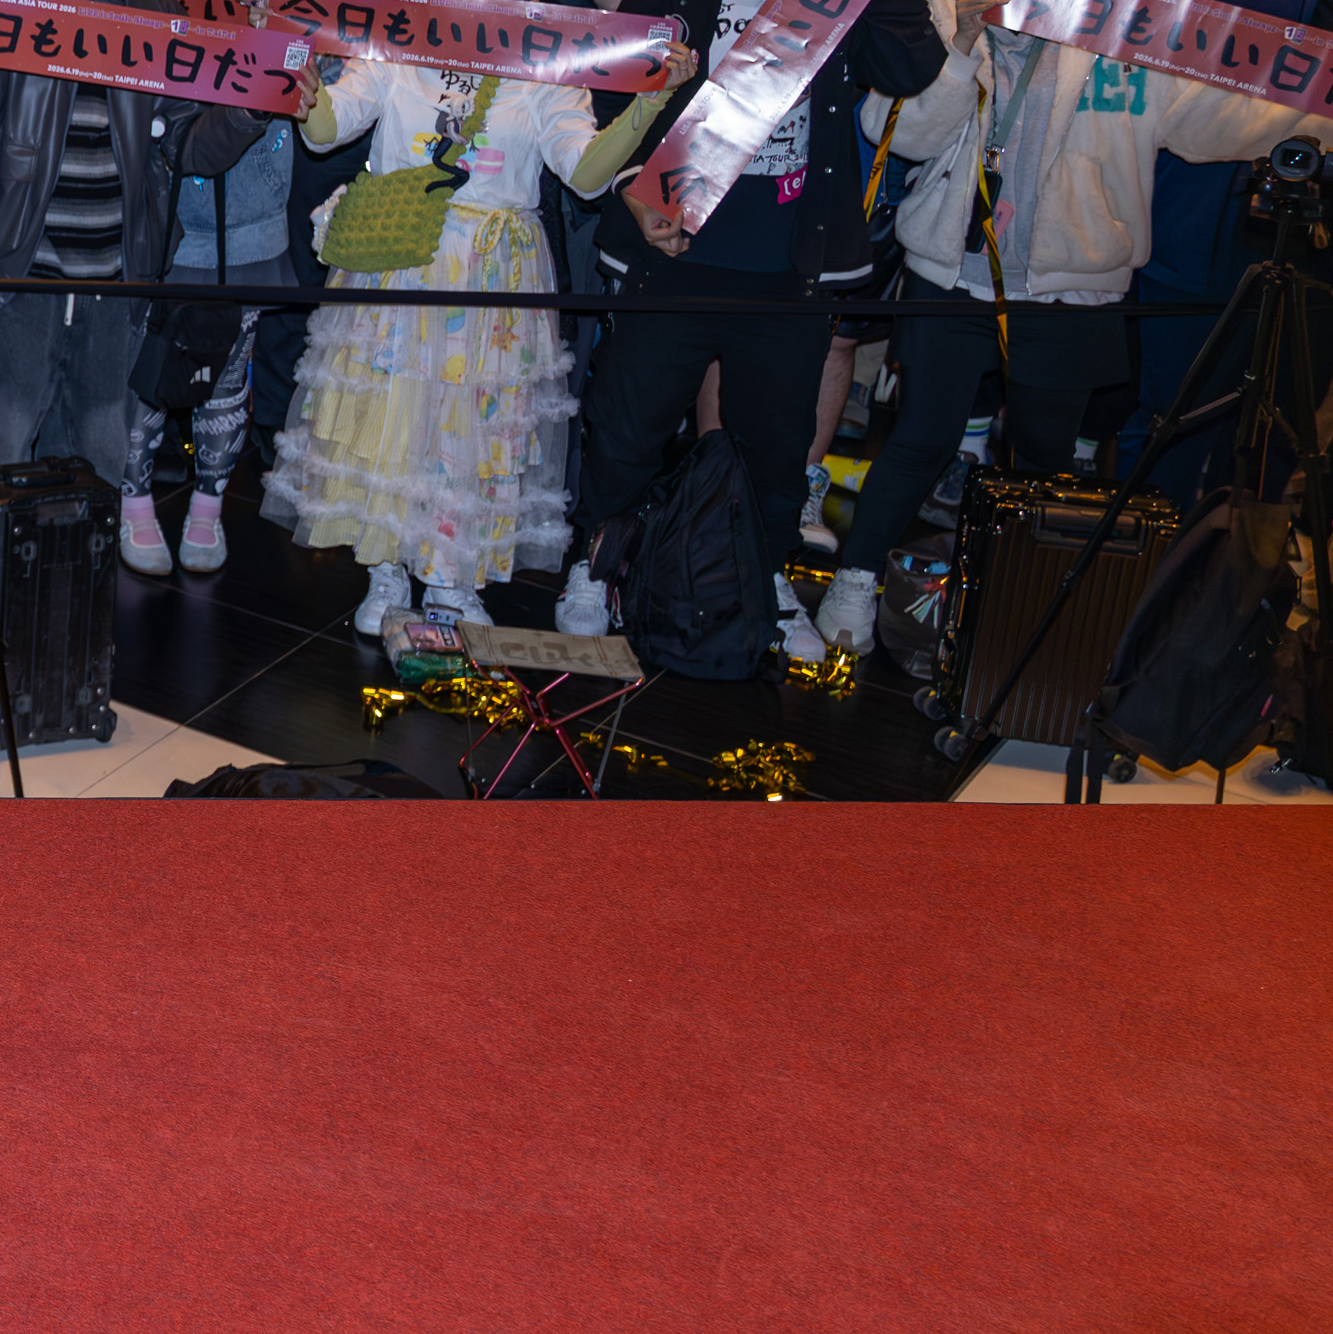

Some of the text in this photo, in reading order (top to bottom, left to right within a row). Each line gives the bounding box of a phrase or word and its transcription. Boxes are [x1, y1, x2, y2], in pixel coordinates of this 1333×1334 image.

[37, 0, 58, 10] TOUR
[59, 3, 77, 13] 2026
[471, 60, 494, 71] TAIPEI
[495, 63, 523, 75] ARENA
[115, 75, 136, 86] TAIPEI
[138, 78, 165, 90] ARENA
[1209, 73, 1236, 87] TAIPEI
[1236, 80, 1267, 96] ARENA
[767, 153, 792, 164] TOUR
